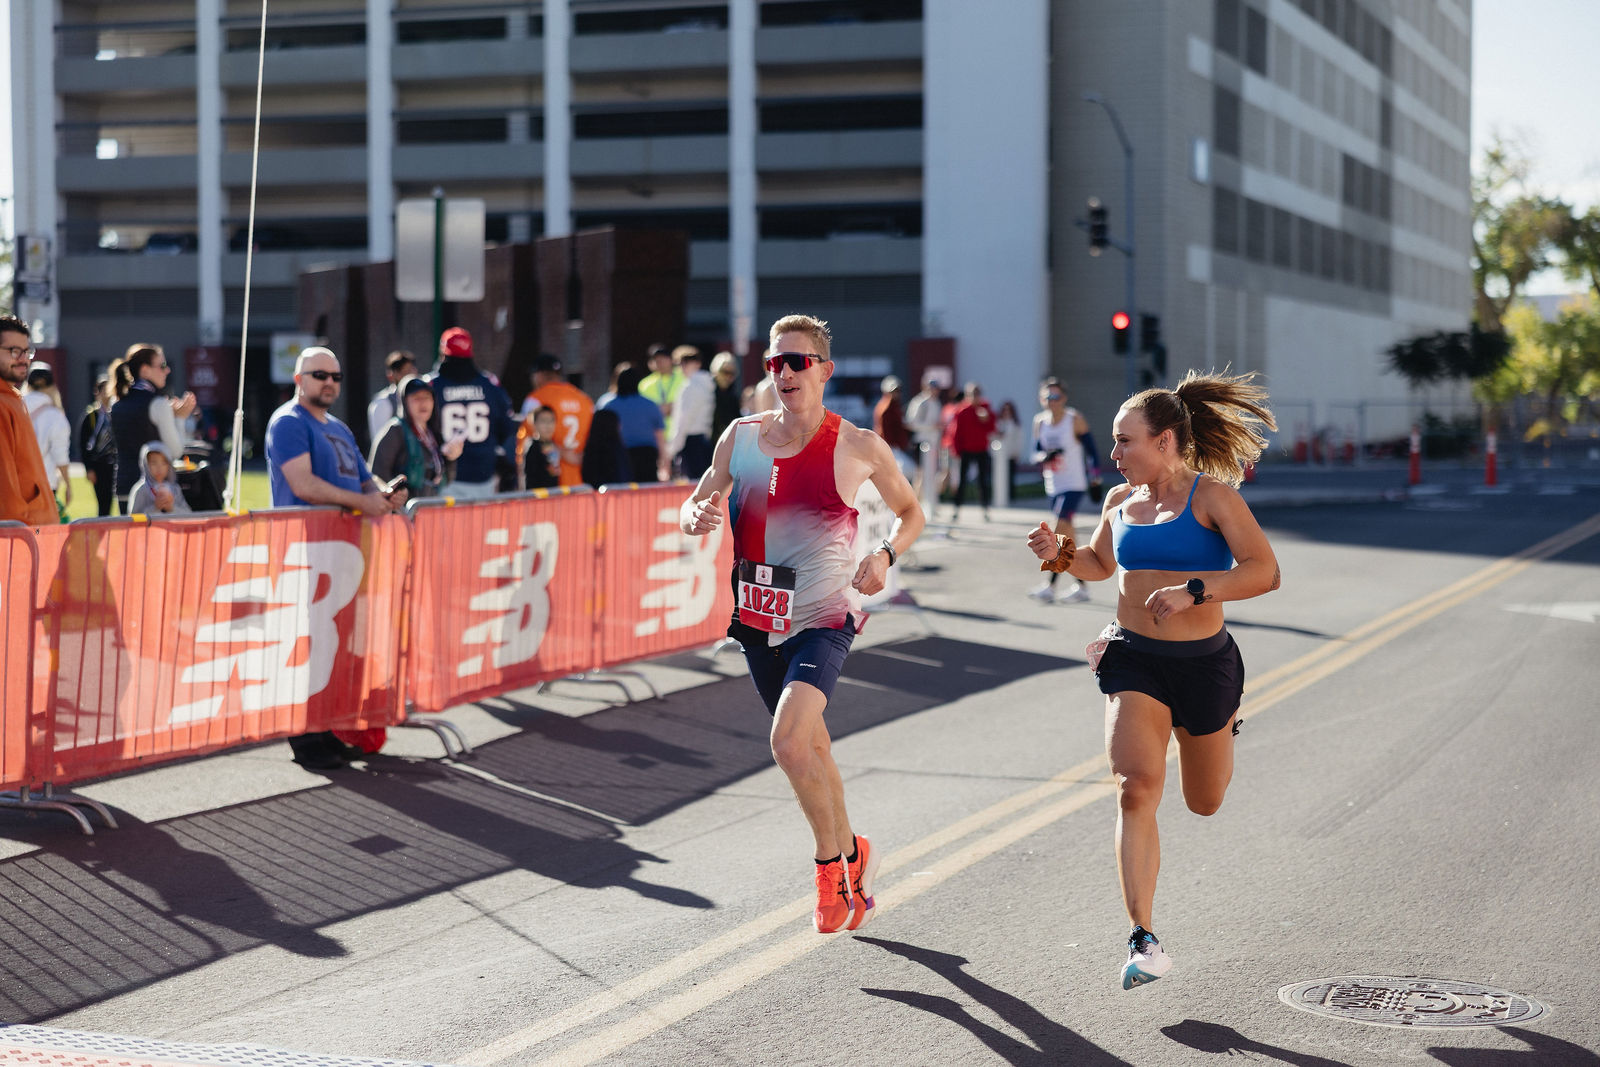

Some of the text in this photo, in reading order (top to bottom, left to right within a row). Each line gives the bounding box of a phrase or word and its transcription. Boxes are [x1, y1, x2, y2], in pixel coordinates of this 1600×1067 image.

[441, 401, 490, 443] 66
[562, 415, 580, 448] 2
[769, 465, 780, 496] BANDIT
[743, 584, 789, 617] 1028
